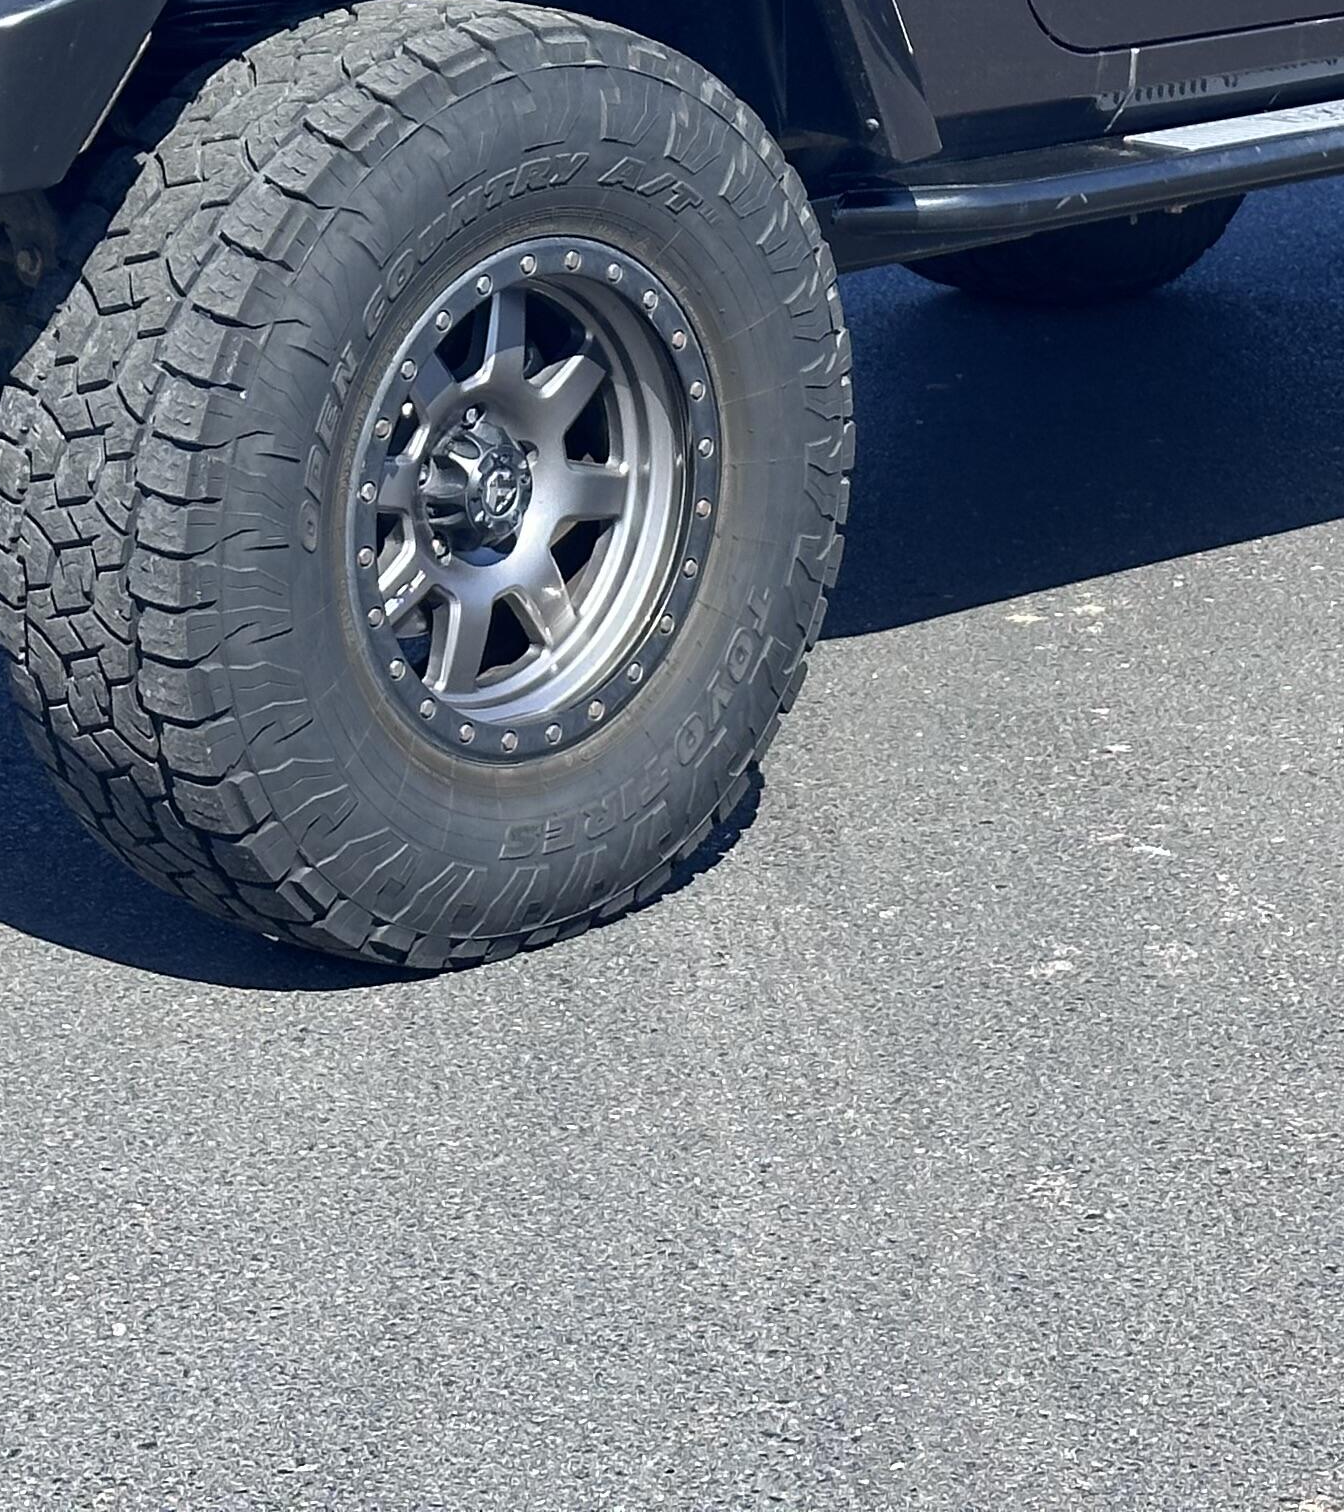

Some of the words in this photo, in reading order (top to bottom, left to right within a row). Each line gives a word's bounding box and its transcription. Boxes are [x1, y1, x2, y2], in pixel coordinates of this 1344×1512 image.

[362, 151, 590, 341] COUNTRY
[598, 156, 704, 216] A/T
[674, 585, 772, 767] TOYO
[498, 754, 671, 861] TIRES
